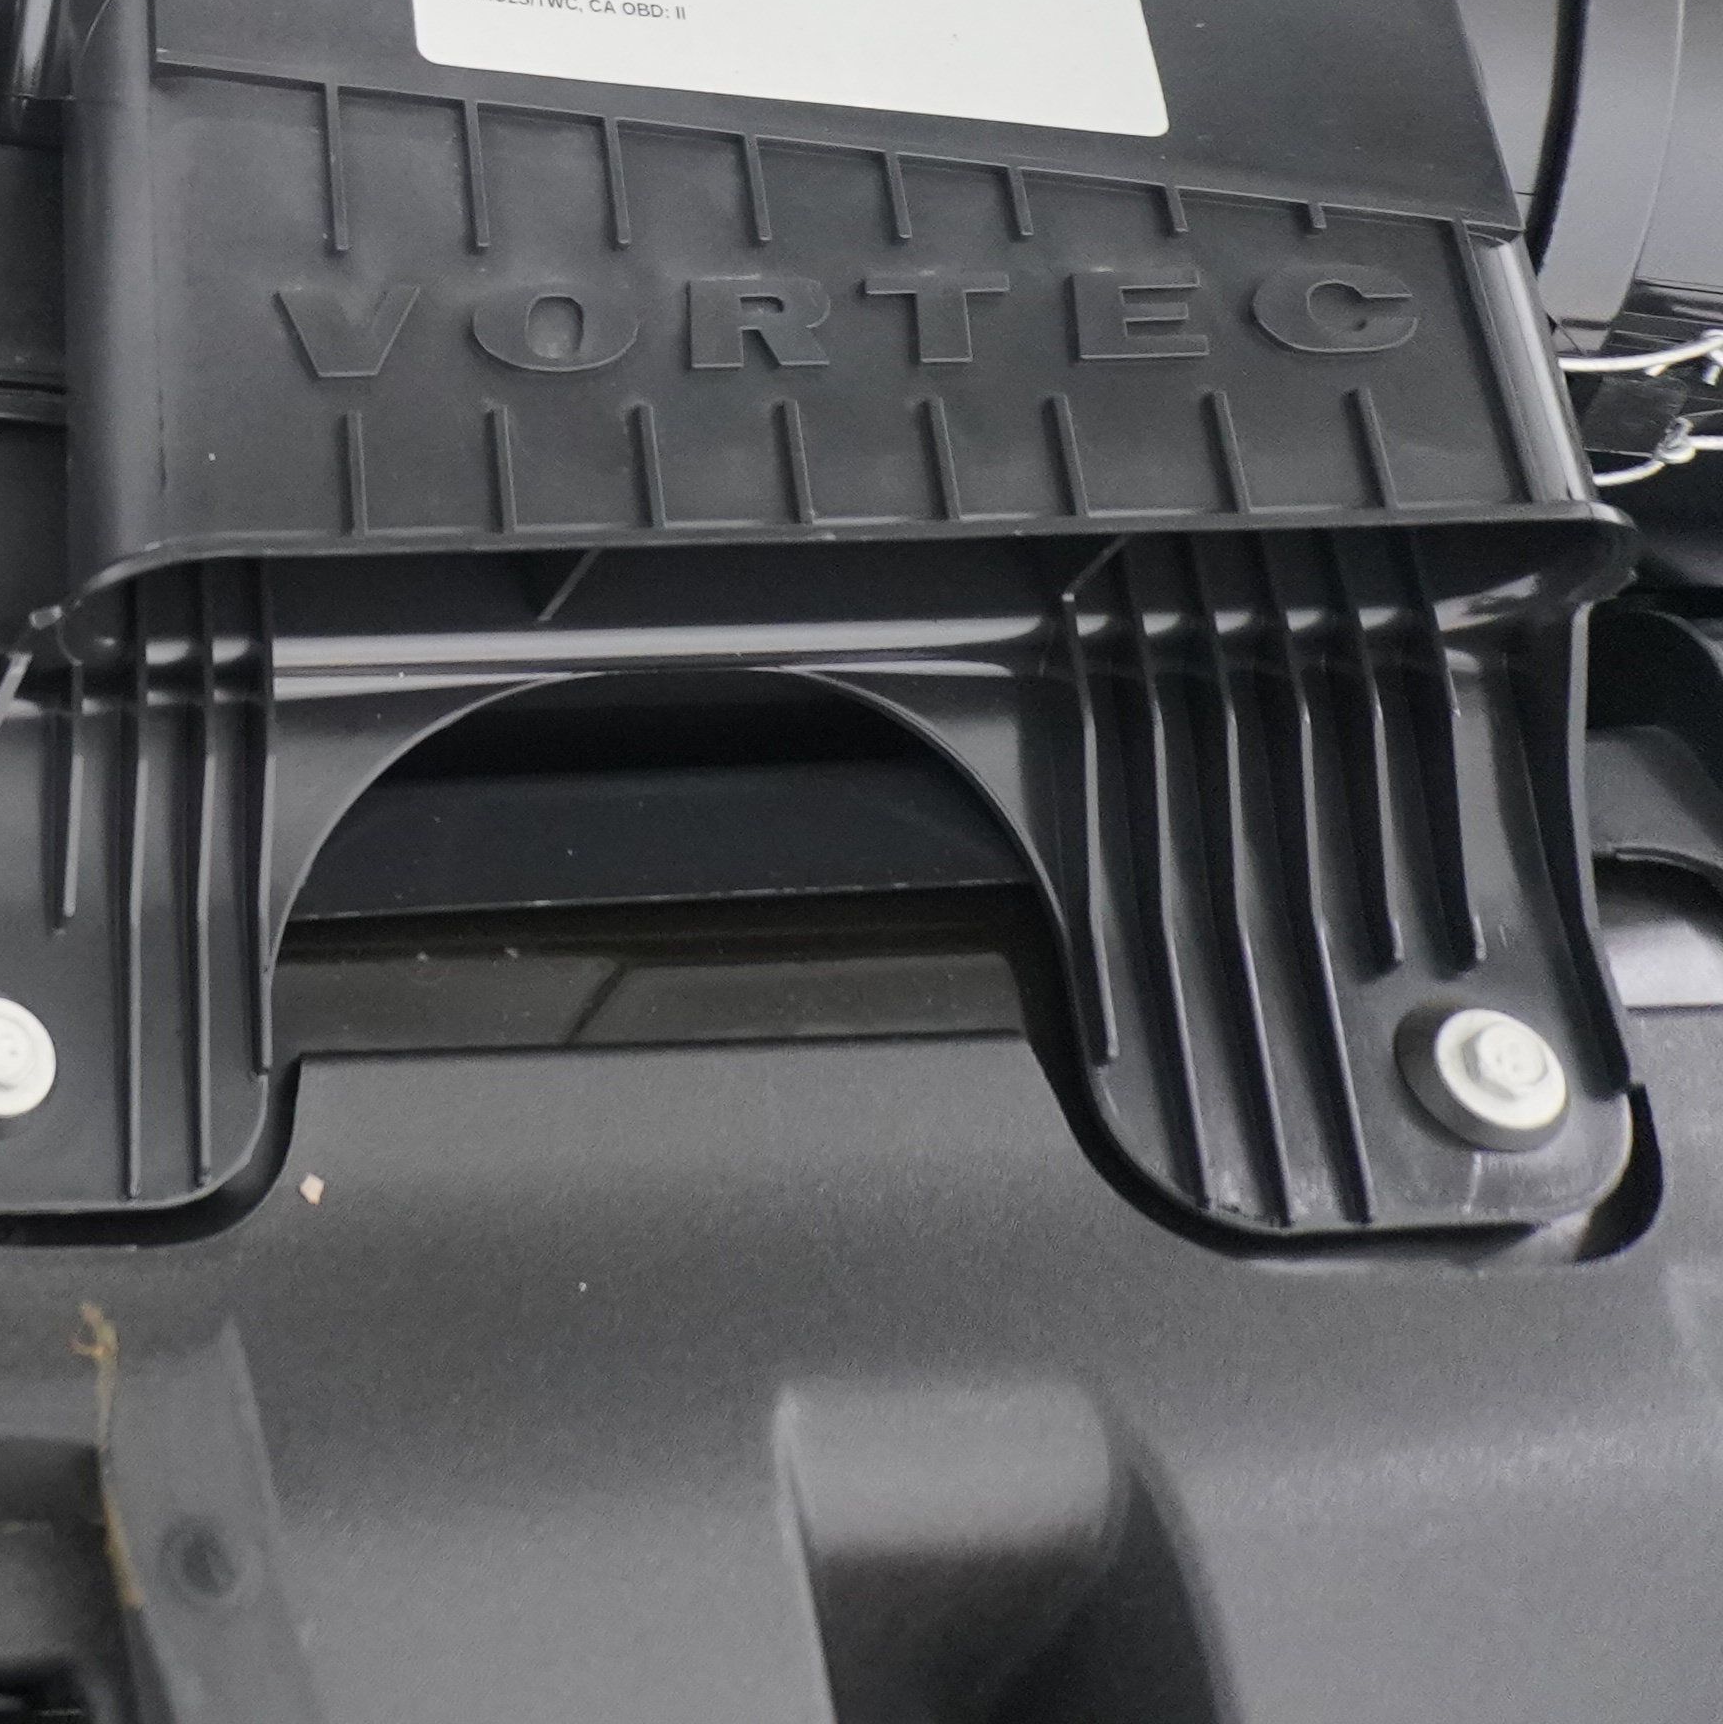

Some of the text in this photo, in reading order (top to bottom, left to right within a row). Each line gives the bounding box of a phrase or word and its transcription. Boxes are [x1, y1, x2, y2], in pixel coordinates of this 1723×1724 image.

[589, 0, 616, 14] CA
[622, 2, 670, 19] OBD:
[273, 269, 1418, 379] VORTEC
